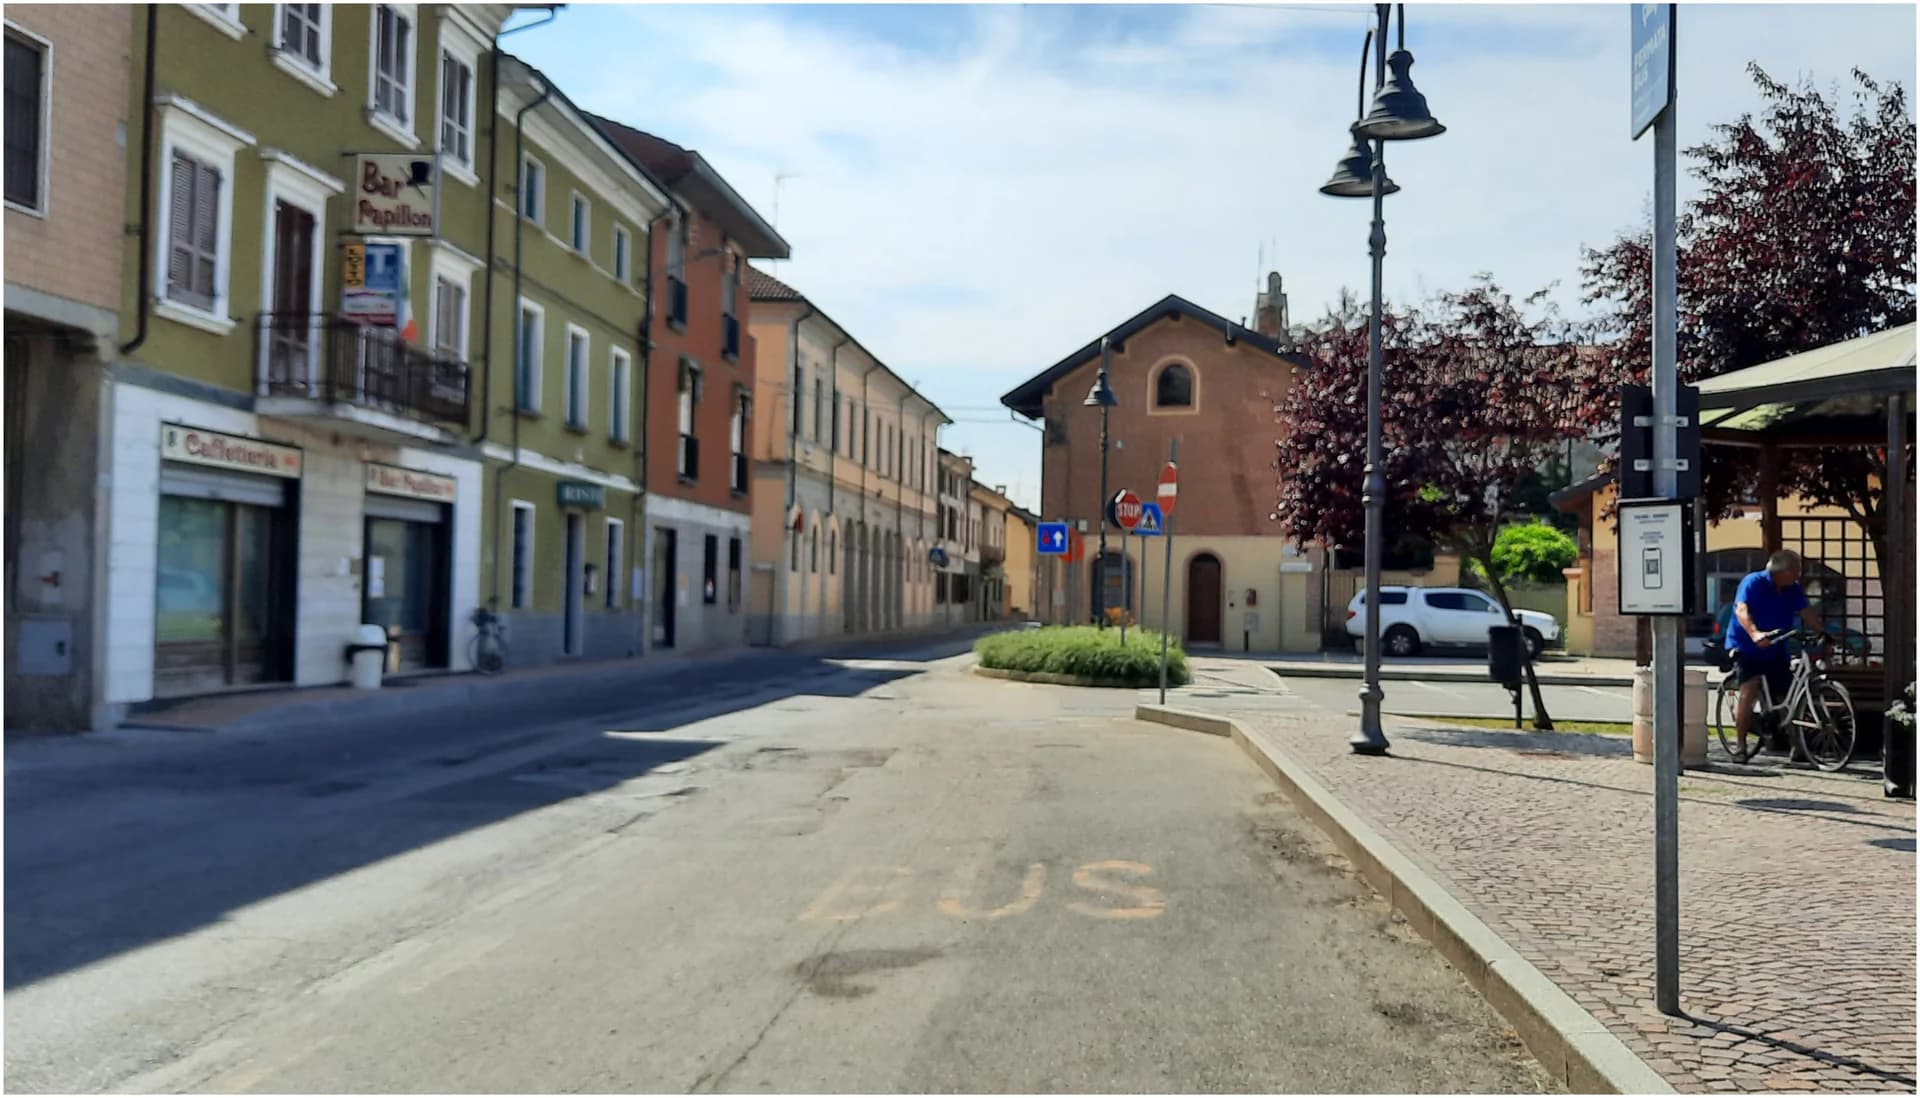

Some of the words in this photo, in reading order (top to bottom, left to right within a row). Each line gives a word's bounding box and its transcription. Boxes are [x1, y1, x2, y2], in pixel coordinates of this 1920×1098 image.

[361, 160, 404, 199] Bar
[358, 199, 432, 232] Papillon
[185, 432, 277, 468] Caffetteria
[1117, 502, 1141, 517] STOP
